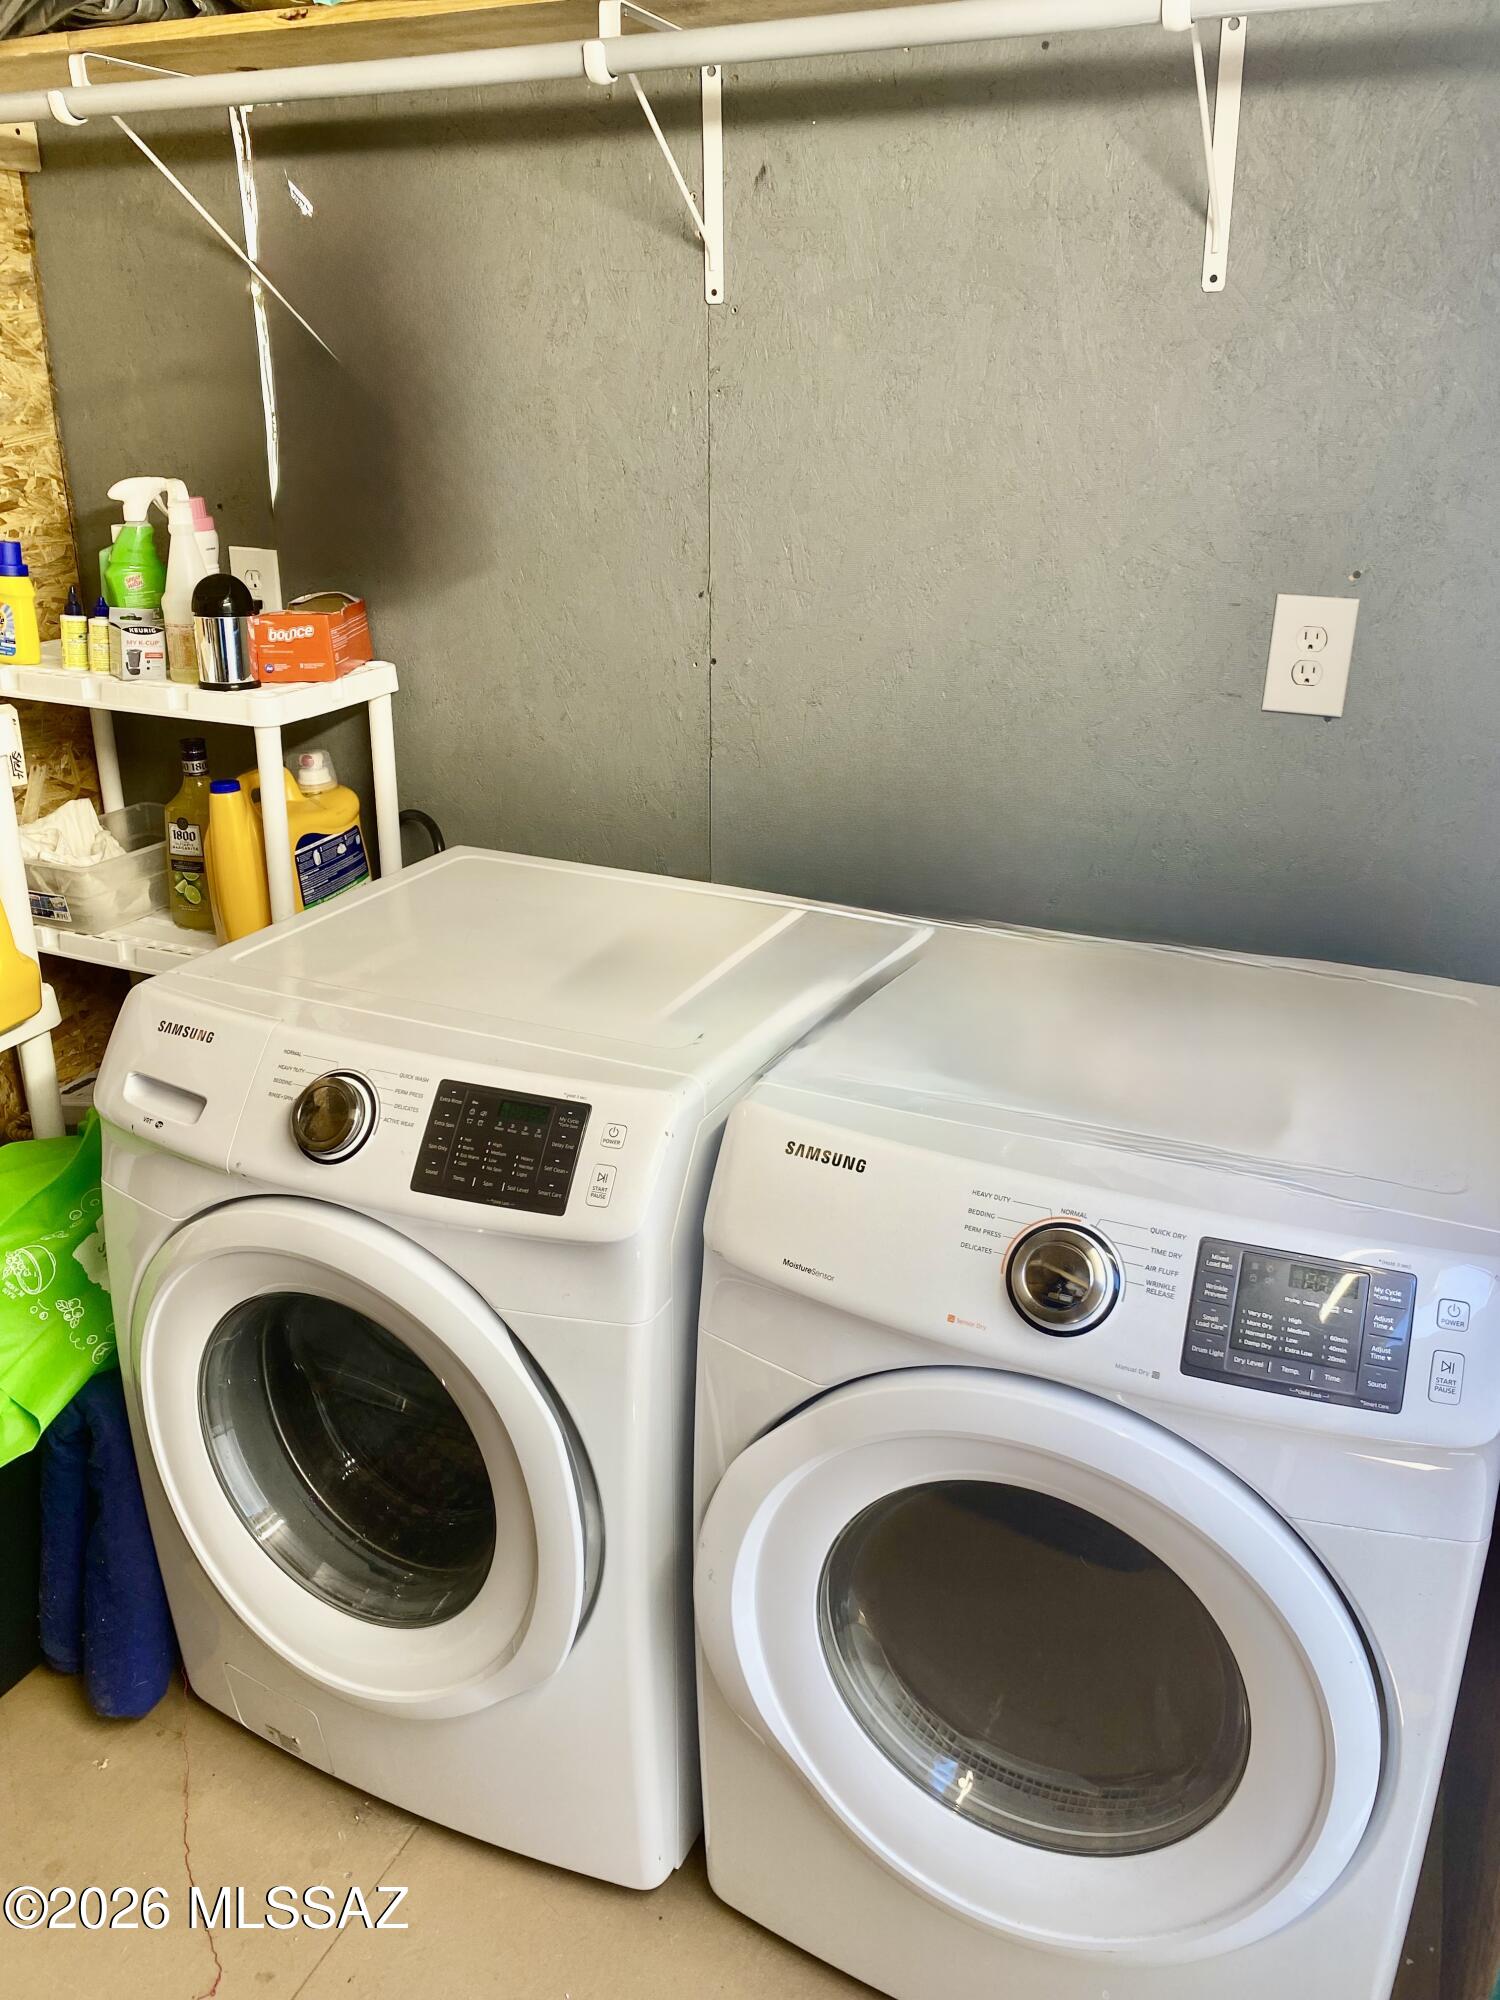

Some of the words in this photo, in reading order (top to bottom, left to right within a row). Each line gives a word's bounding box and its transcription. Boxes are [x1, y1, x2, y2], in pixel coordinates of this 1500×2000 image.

[267, 625, 315, 643] bounce
[172, 829, 196, 842] 1800
[157, 1020, 215, 1044] SAMSUNG
[399, 1072, 414, 1080] QUICK
[414, 1075, 429, 1083] WASH
[394, 1088, 408, 1096] PERM
[408, 1091, 424, 1099] PRESS
[393, 1103, 419, 1113] DELICATES
[383, 1117, 401, 1126] ACTIVE
[402, 1120, 415, 1128] WEAR
[567, 1117, 580, 1125] Cycle
[551, 1141, 565, 1150] Delay
[602, 1138, 621, 1146] POWER
[785, 1140, 867, 1173] SAMSUNG
[425, 1168, 439, 1176] Sound
[516, 1186, 529, 1194] Level
[537, 1189, 551, 1197] Smart
[592, 1185, 608, 1193] START
[972, 1189, 992, 1199] HEAVY
[993, 1194, 1011, 1203] DUTY
[967, 1207, 996, 1220] BEDDING
[1060, 1207, 1088, 1219] NORMAL
[964, 1224, 981, 1234] PERM
[982, 1228, 1002, 1239] PRESS
[1150, 1226, 1171, 1238] QUICK
[1172, 1231, 1188, 1241] DRY
[960, 1241, 993, 1255] DELICATES
[1150, 1247, 1167, 1258] TIME
[1168, 1250, 1183, 1260] DRY
[1211, 1253, 1230, 1263] Mixed
[1205, 1259, 1221, 1269] Load
[1144, 1264, 1157, 1273] AIR
[1157, 1267, 1180, 1278] FLUFF
[1145, 1279, 1176, 1292] WRINKLE
[1205, 1282, 1229, 1293] Wrinkle
[1145, 1287, 1176, 1300] RELEASE
[1204, 1290, 1228, 1300] Prevent
[1373, 1286, 1385, 1295] My
[1385, 1288, 1402, 1297] Cycle
[1202, 1313, 1219, 1323] Small
[1247, 1309, 1262, 1318] Very
[1262, 1311, 1273, 1320] Dry
[1373, 1315, 1394, 1325] Adjust
[976, 1321, 987, 1331] Dry
[1195, 1319, 1210, 1329] Load
[1246, 1319, 1262, 1328] More
[1262, 1322, 1273, 1330] Dry
[1288, 1316, 1302, 1325] High
[1440, 1318, 1465, 1328] POWER
[1286, 1326, 1310, 1337] Medium
[1373, 1322, 1388, 1331] Time
[1245, 1328, 1266, 1339] Normal
[1266, 1332, 1278, 1341] Dry
[1329, 1335, 1349, 1345] 60min
[1243, 1338, 1260, 1348] Damp
[1260, 1341, 1272, 1350] Dry
[1285, 1336, 1298, 1345] Low
[1191, 1344, 1208, 1354] Drum
[1208, 1347, 1224, 1358] Light
[1284, 1346, 1300, 1355] Extra
[1300, 1349, 1313, 1358] Low
[1328, 1345, 1348, 1354] 40min
[1371, 1346, 1392, 1356] Adjust
[1233, 1355, 1246, 1365] Dry
[1246, 1357, 1264, 1368] Level
[1327, 1355, 1347, 1364] 20min
[1370, 1353, 1386, 1361] Time
[1114, 1362, 1138, 1374] Manual
[1138, 1367, 1150, 1377] Dry
[1367, 1380, 1387, 1390] Sound
[1435, 1376, 1456, 1387] START
[1434, 1386, 1456, 1396] PAUSE
